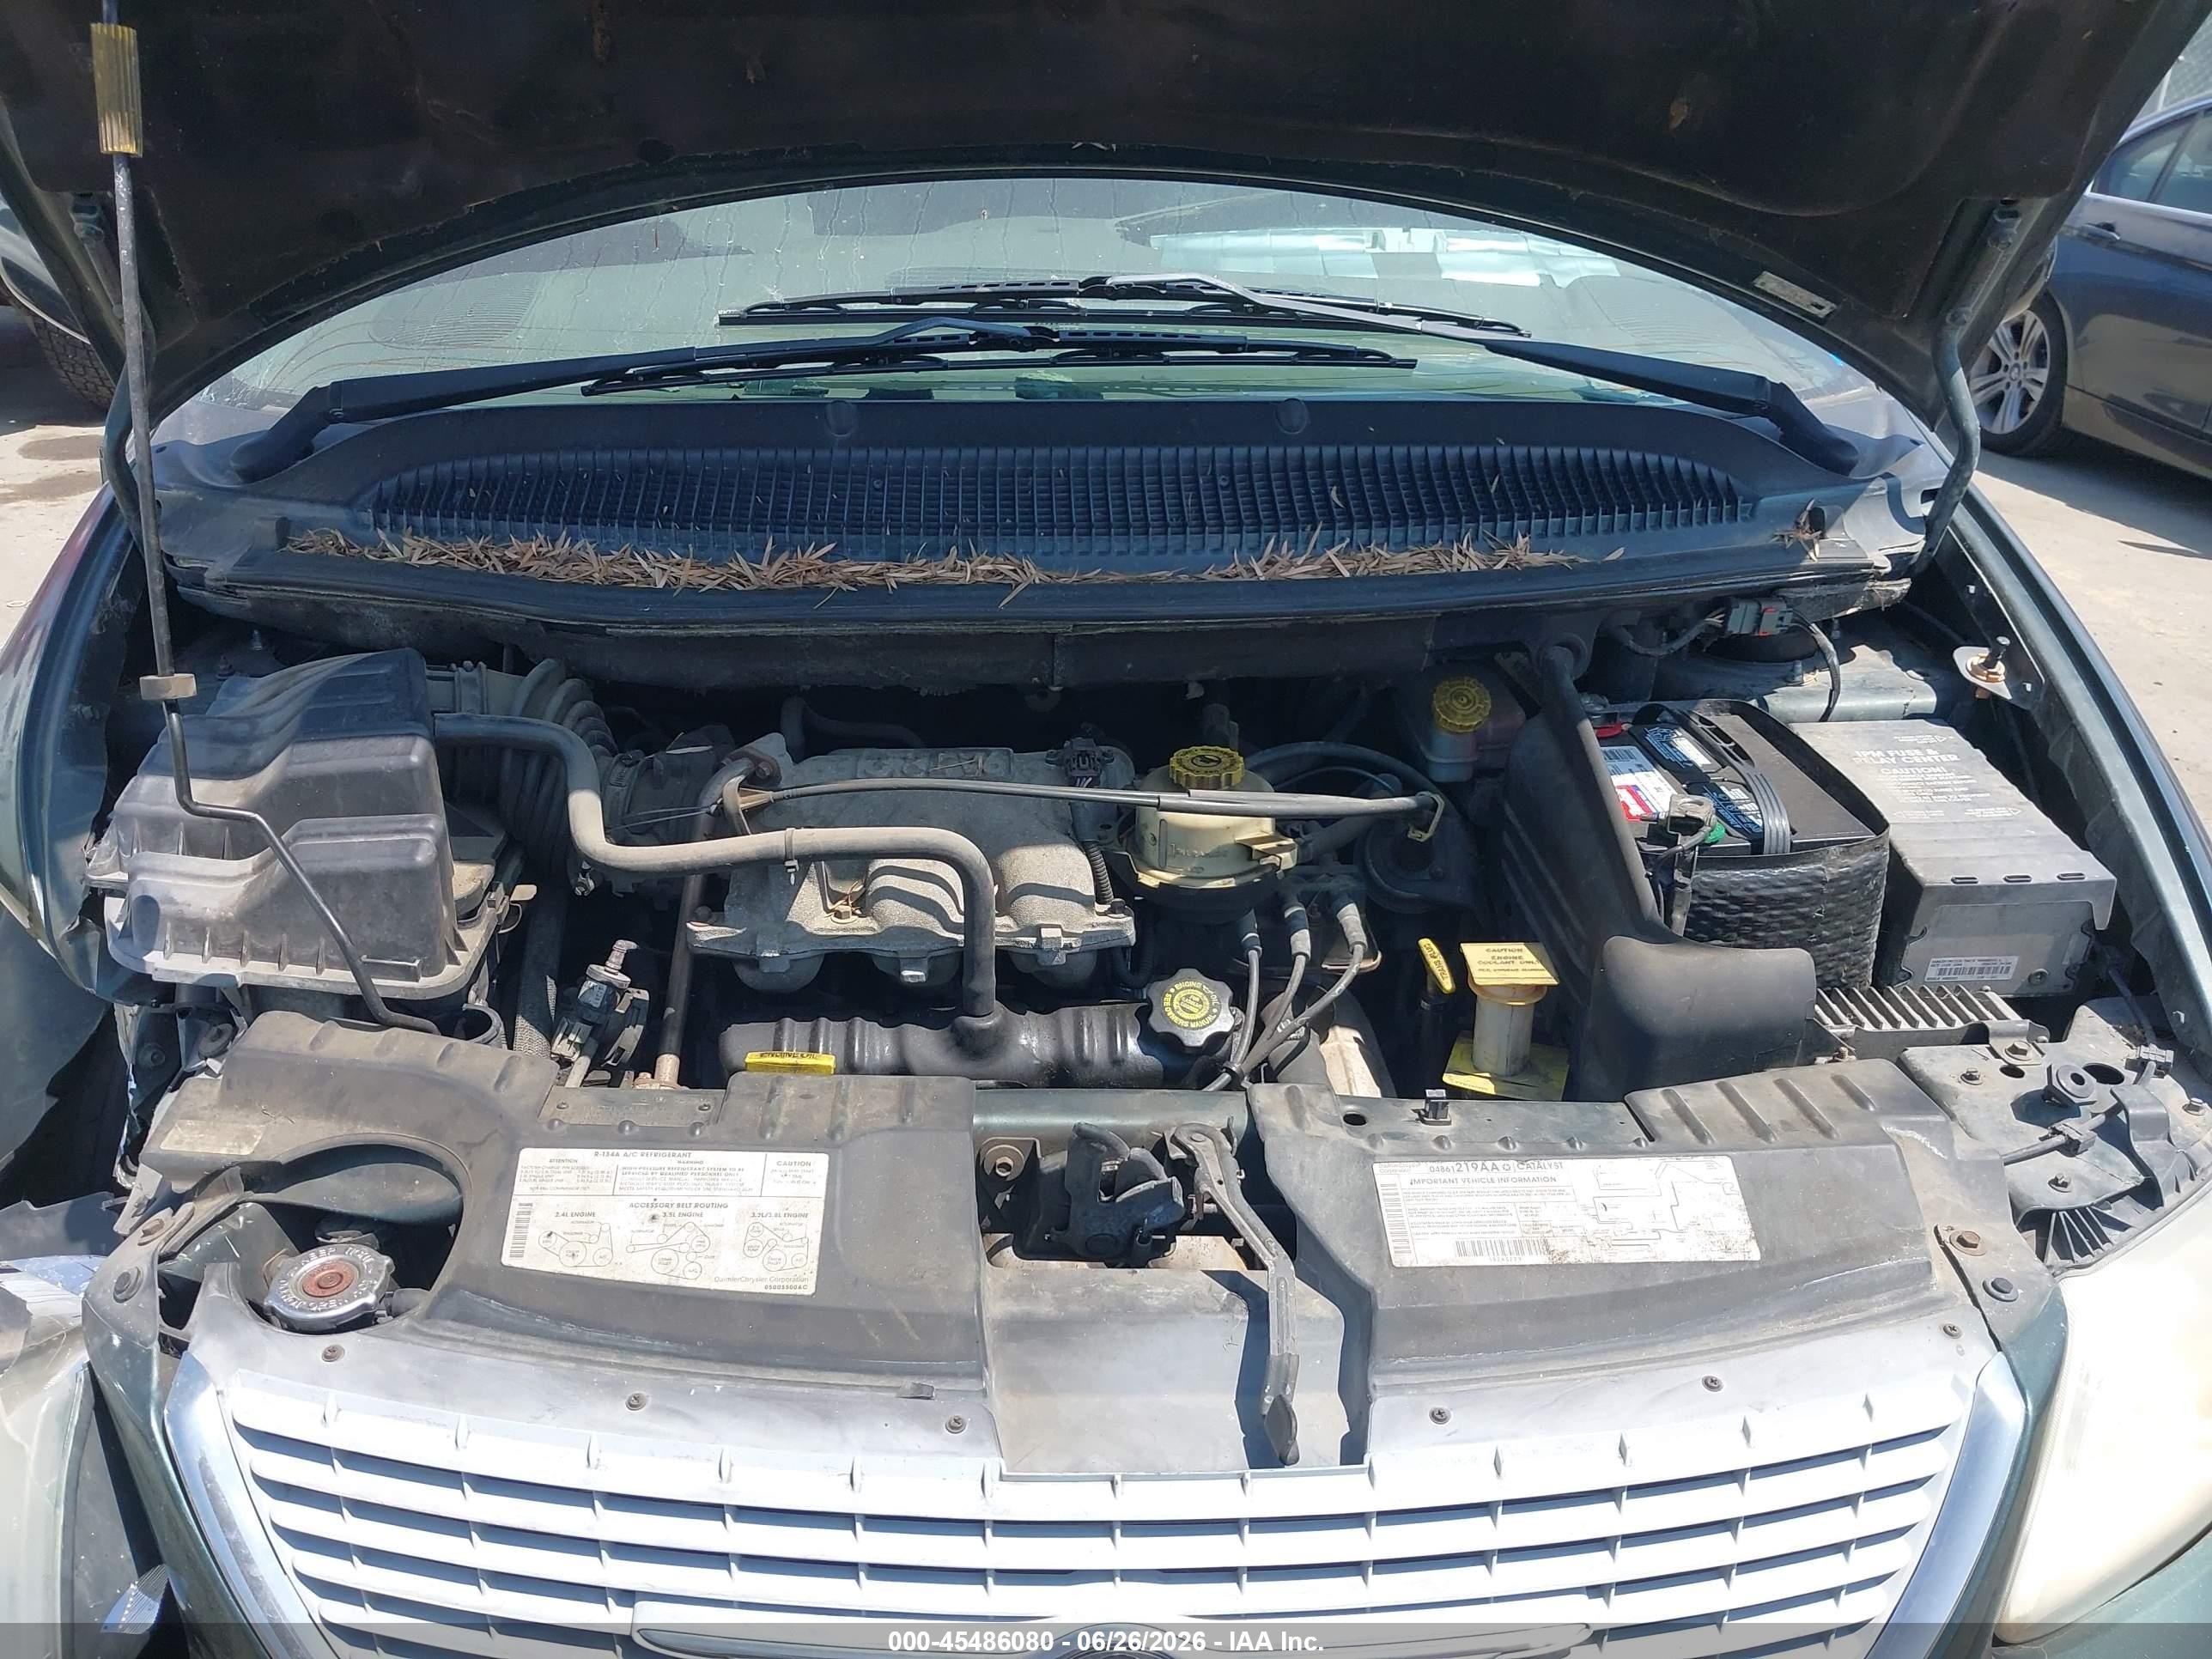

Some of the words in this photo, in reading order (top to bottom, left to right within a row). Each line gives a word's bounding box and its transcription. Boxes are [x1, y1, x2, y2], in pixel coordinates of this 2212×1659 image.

[1886, 749, 1924, 757] FUSE
[1900, 754, 1961, 763] CENTER
[1164, 993, 1172, 1006] SEE
[1174, 981, 1203, 990] ENGINE
[1210, 994, 1220, 1006] OIL
[1164, 1007, 1189, 1028] OWNERS
[1190, 1014, 1217, 1028] MANUAL
[1516, 1161, 1564, 1170] CATALYST
